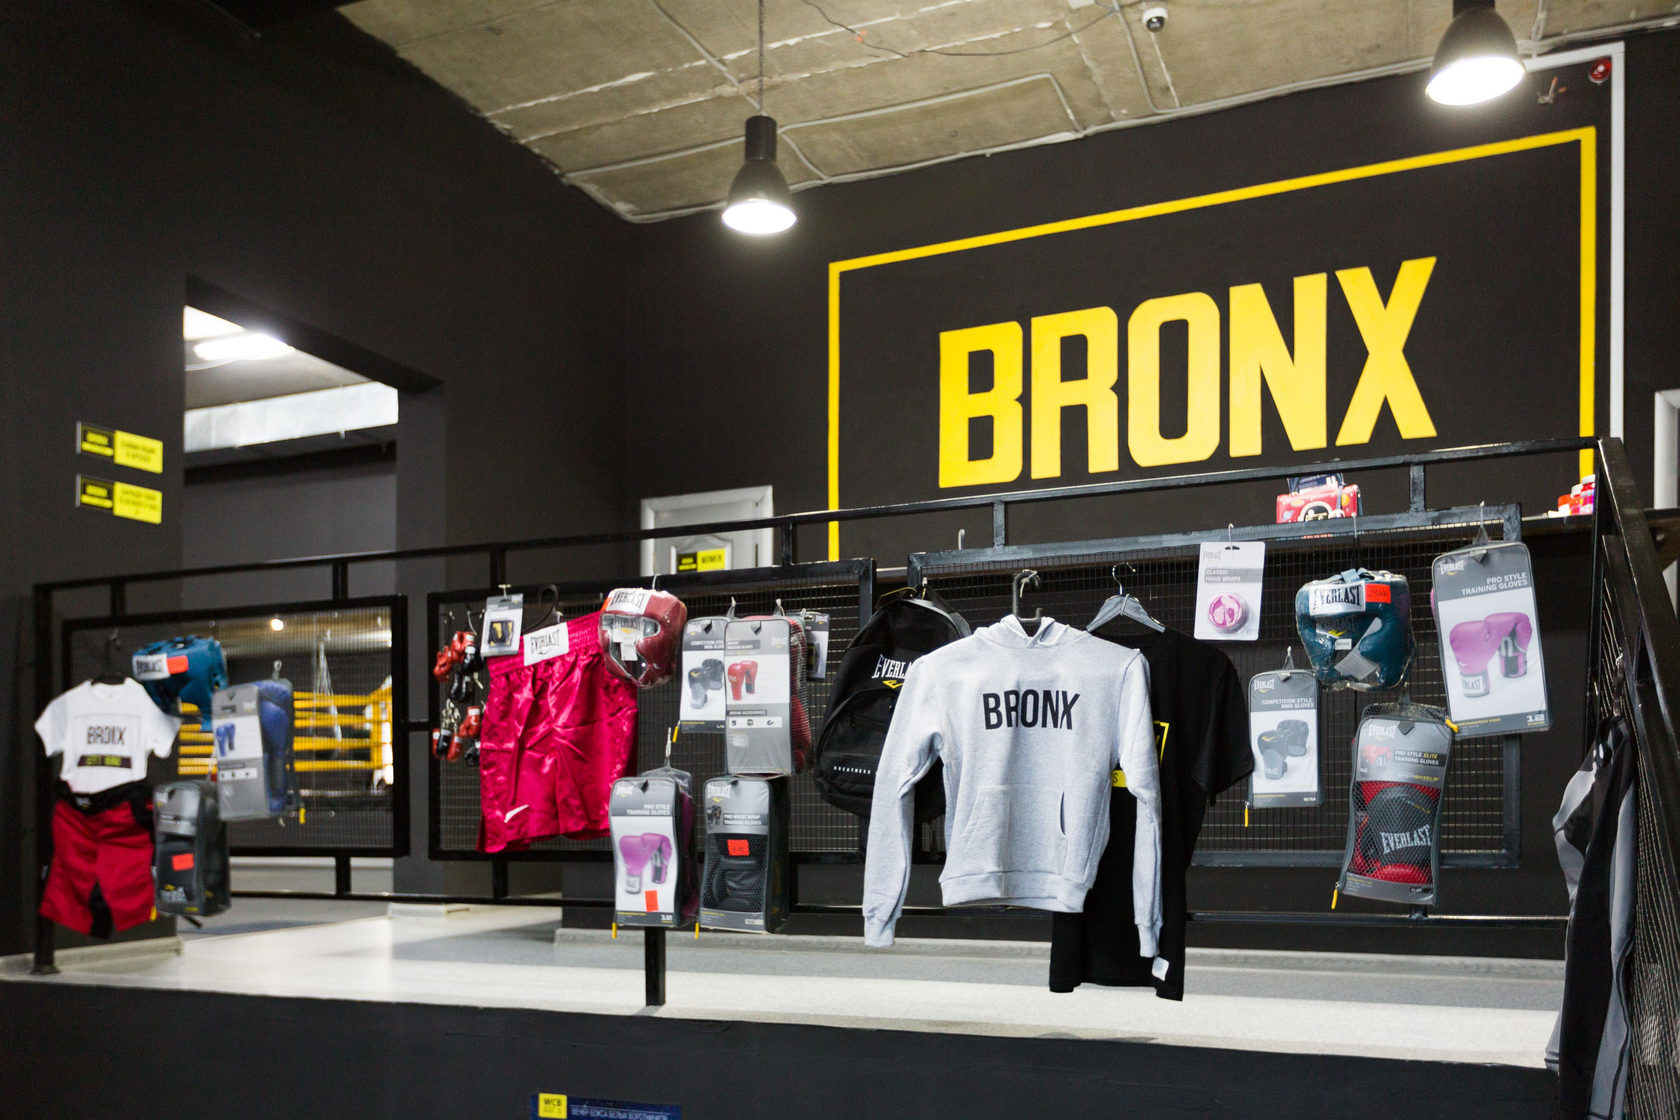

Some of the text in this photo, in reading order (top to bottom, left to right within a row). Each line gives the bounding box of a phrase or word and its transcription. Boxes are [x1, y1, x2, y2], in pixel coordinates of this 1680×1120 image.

[939, 256, 1437, 488] BRONX
[1486, 571, 1527, 585] PRO STYLE
[1461, 579, 1528, 596] TRAINING GLOVES
[530, 629, 560, 655] EVERLAST
[982, 689, 1080, 730] BRONX
[1368, 723, 1397, 738] EVERLAST
[1394, 755, 1439, 766] TRAINING GLOVES
[1423, 752, 1438, 760] ELITE
[1379, 824, 1432, 855] EVERLAST
